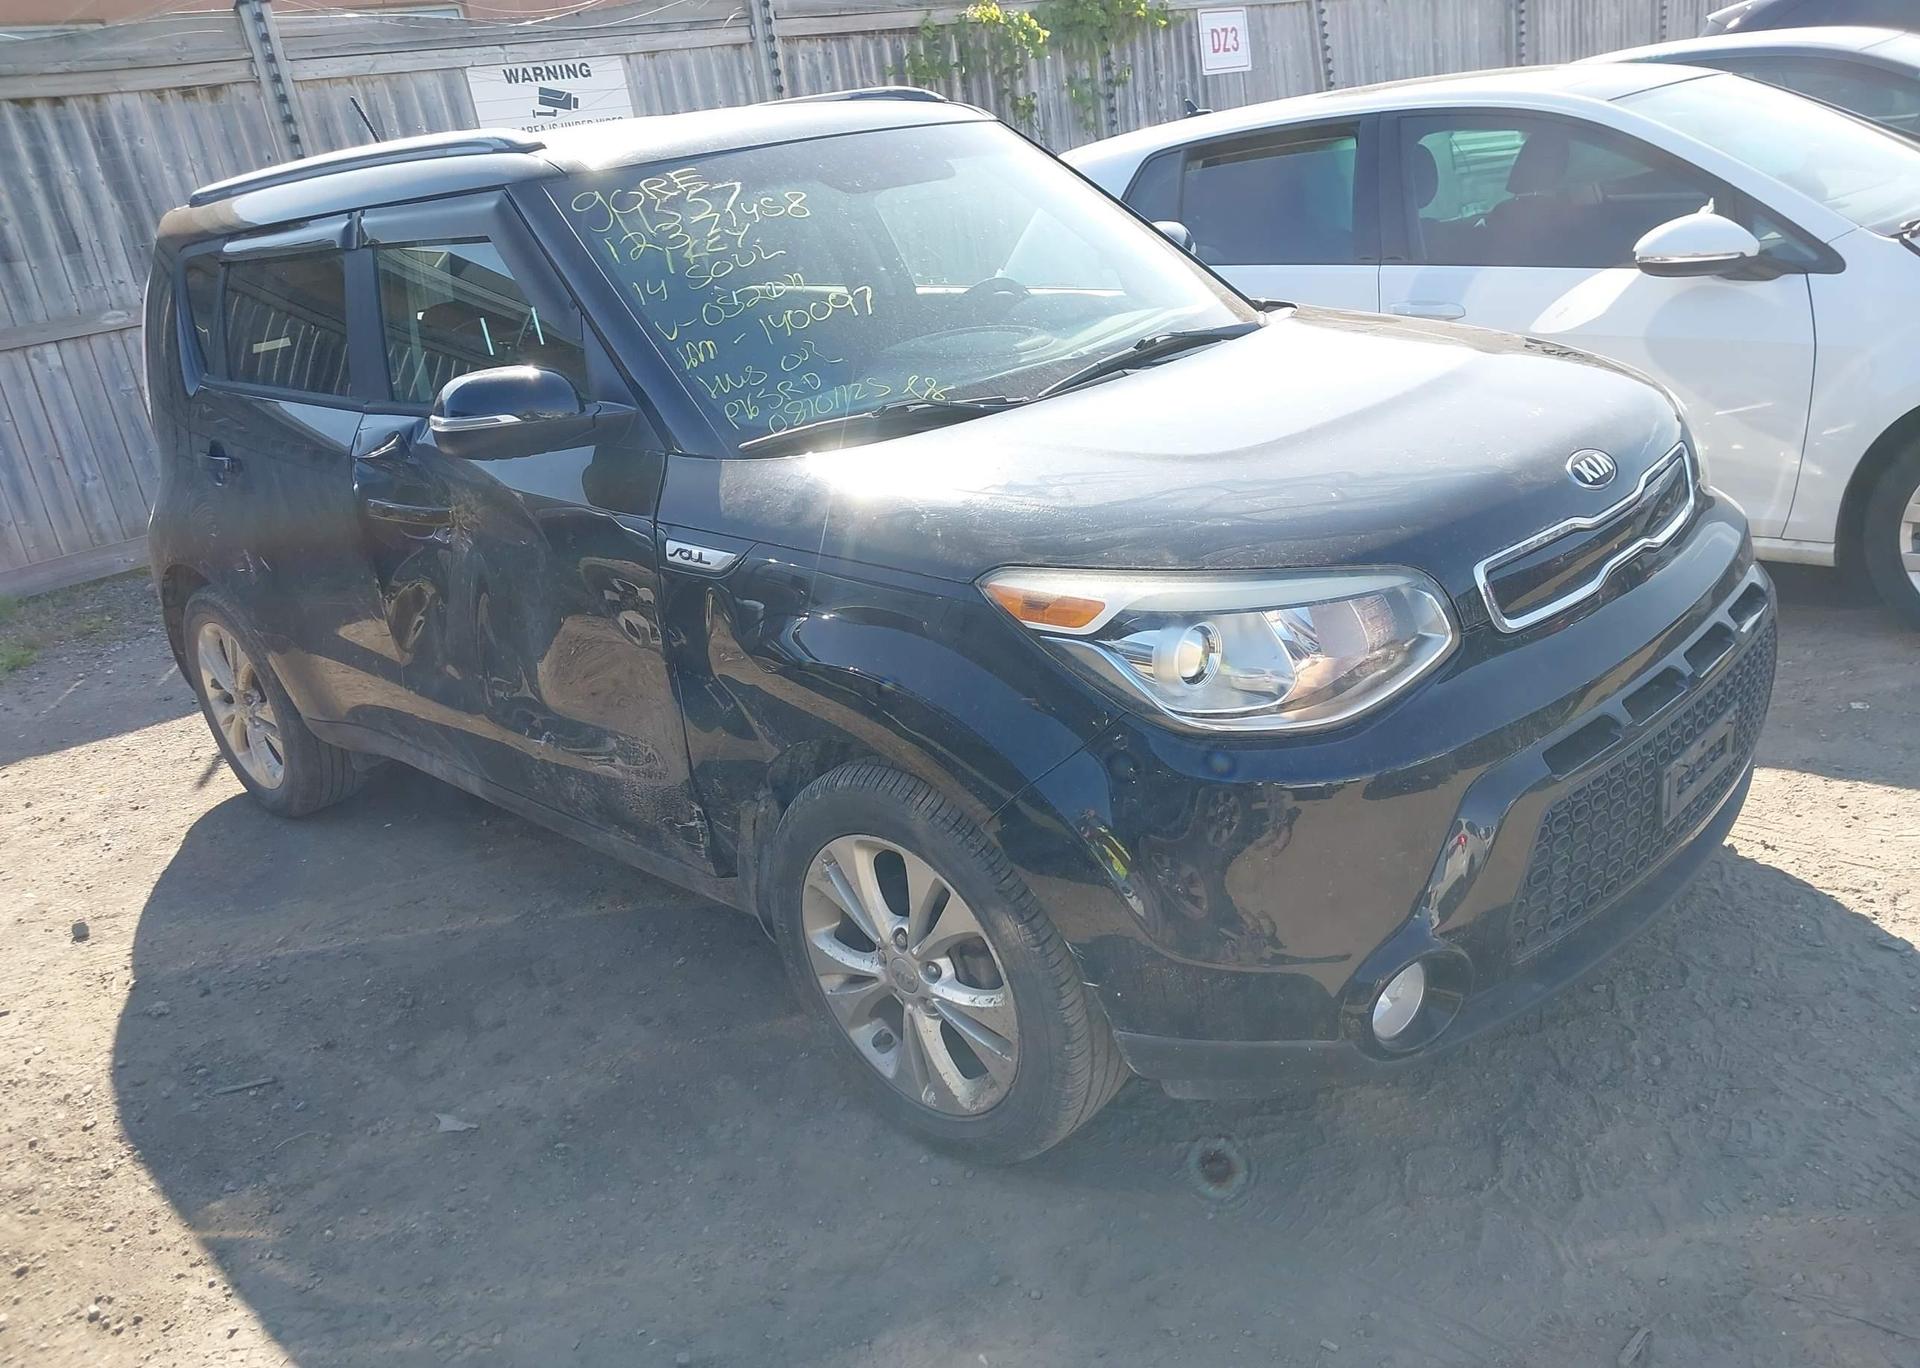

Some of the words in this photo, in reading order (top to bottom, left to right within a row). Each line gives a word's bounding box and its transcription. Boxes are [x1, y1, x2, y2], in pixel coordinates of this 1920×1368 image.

[1210, 26, 1240, 54] DZ3
[502, 62, 592, 84] WARNING
[1573, 453, 1614, 483] KIA
